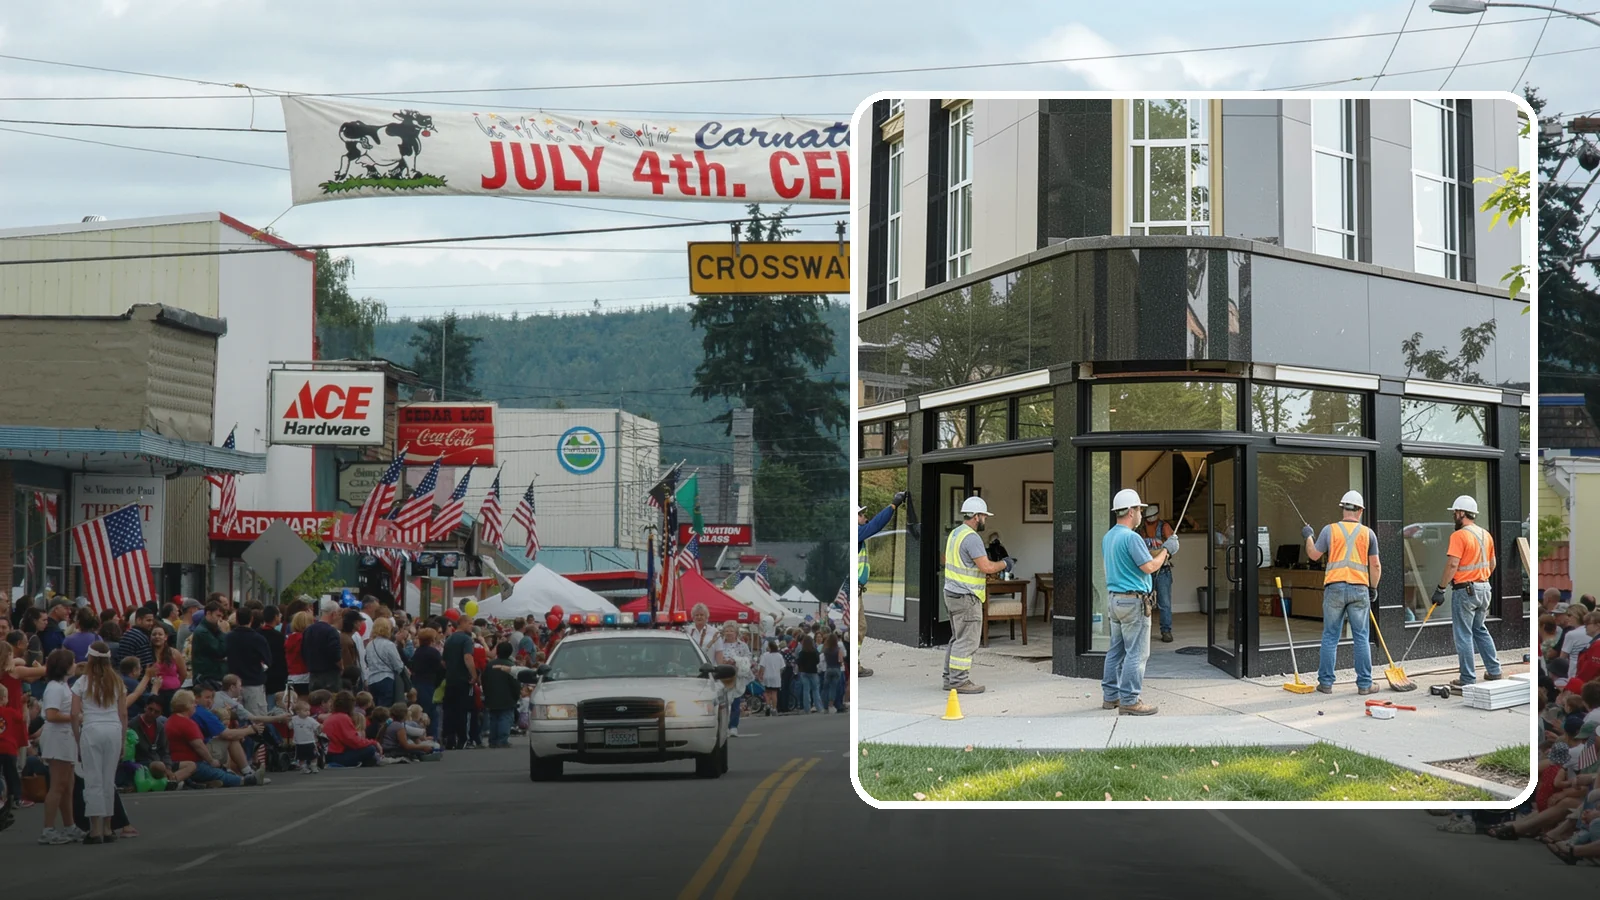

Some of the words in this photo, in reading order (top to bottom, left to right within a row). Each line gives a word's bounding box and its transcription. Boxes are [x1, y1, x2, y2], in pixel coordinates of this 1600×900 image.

[481, 141, 604, 192] JULY
[632, 149, 747, 197] 4th.
[697, 254, 850, 280] CROSSWA
[282, 379, 374, 420] ACE
[405, 409, 453, 423] CEDAR
[461, 409, 485, 422] LOG
[283, 421, 371, 437] Hardware
[416, 427, 477, 447] Coca-Cola
[83, 485, 94, 494] St.
[95, 484, 124, 495] Vincent
[125, 485, 136, 495] de
[137, 485, 155, 495] Paul
[688, 526, 741, 535] CRNATION
[699, 535, 730, 544] GLASS
